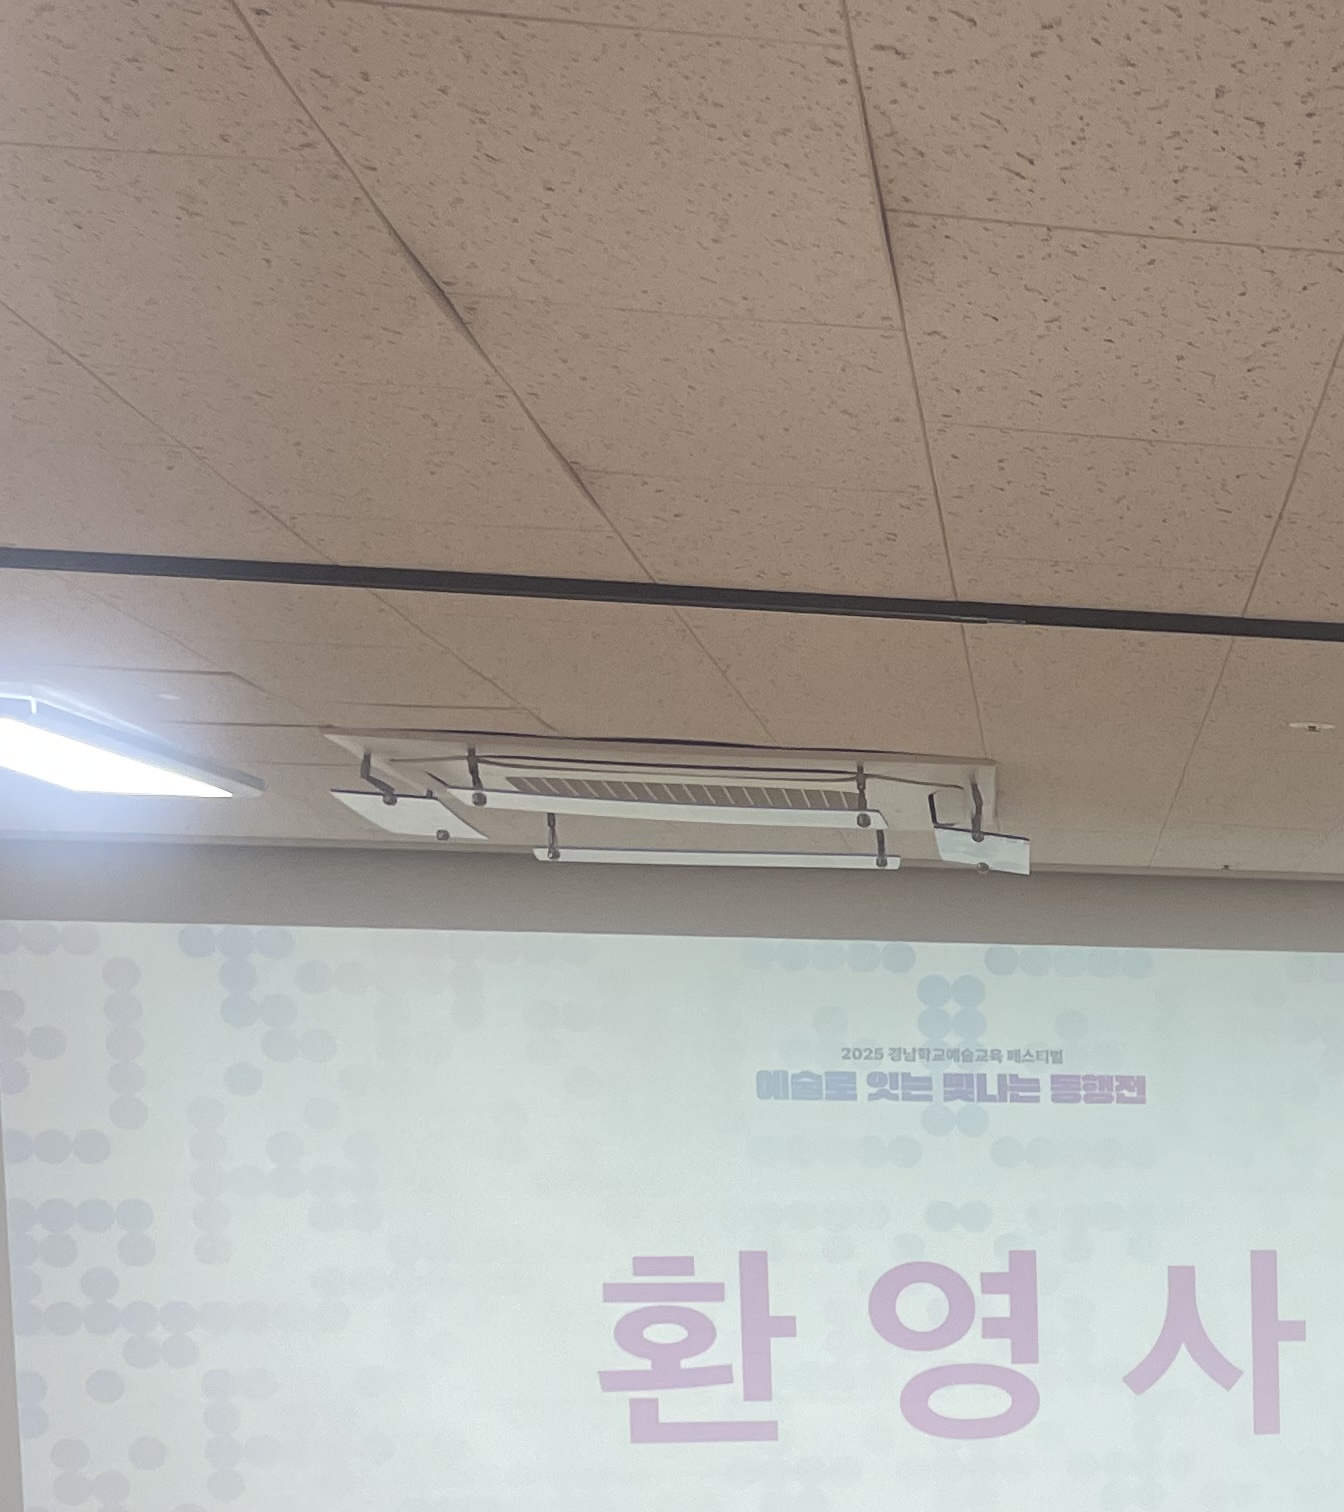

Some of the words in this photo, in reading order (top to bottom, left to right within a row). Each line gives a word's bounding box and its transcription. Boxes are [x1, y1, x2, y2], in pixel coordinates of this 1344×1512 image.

[841, 1046, 885, 1061] 2025
[888, 1046, 1003, 1064] 경남학교예술교육
[1006, 1048, 1064, 1065] 페스티벌
[756, 1069, 858, 1101] 예술로
[866, 1071, 934, 1102] 잇는
[942, 1072, 1041, 1104] 빛나는
[1050, 1074, 1147, 1105] 동행전
